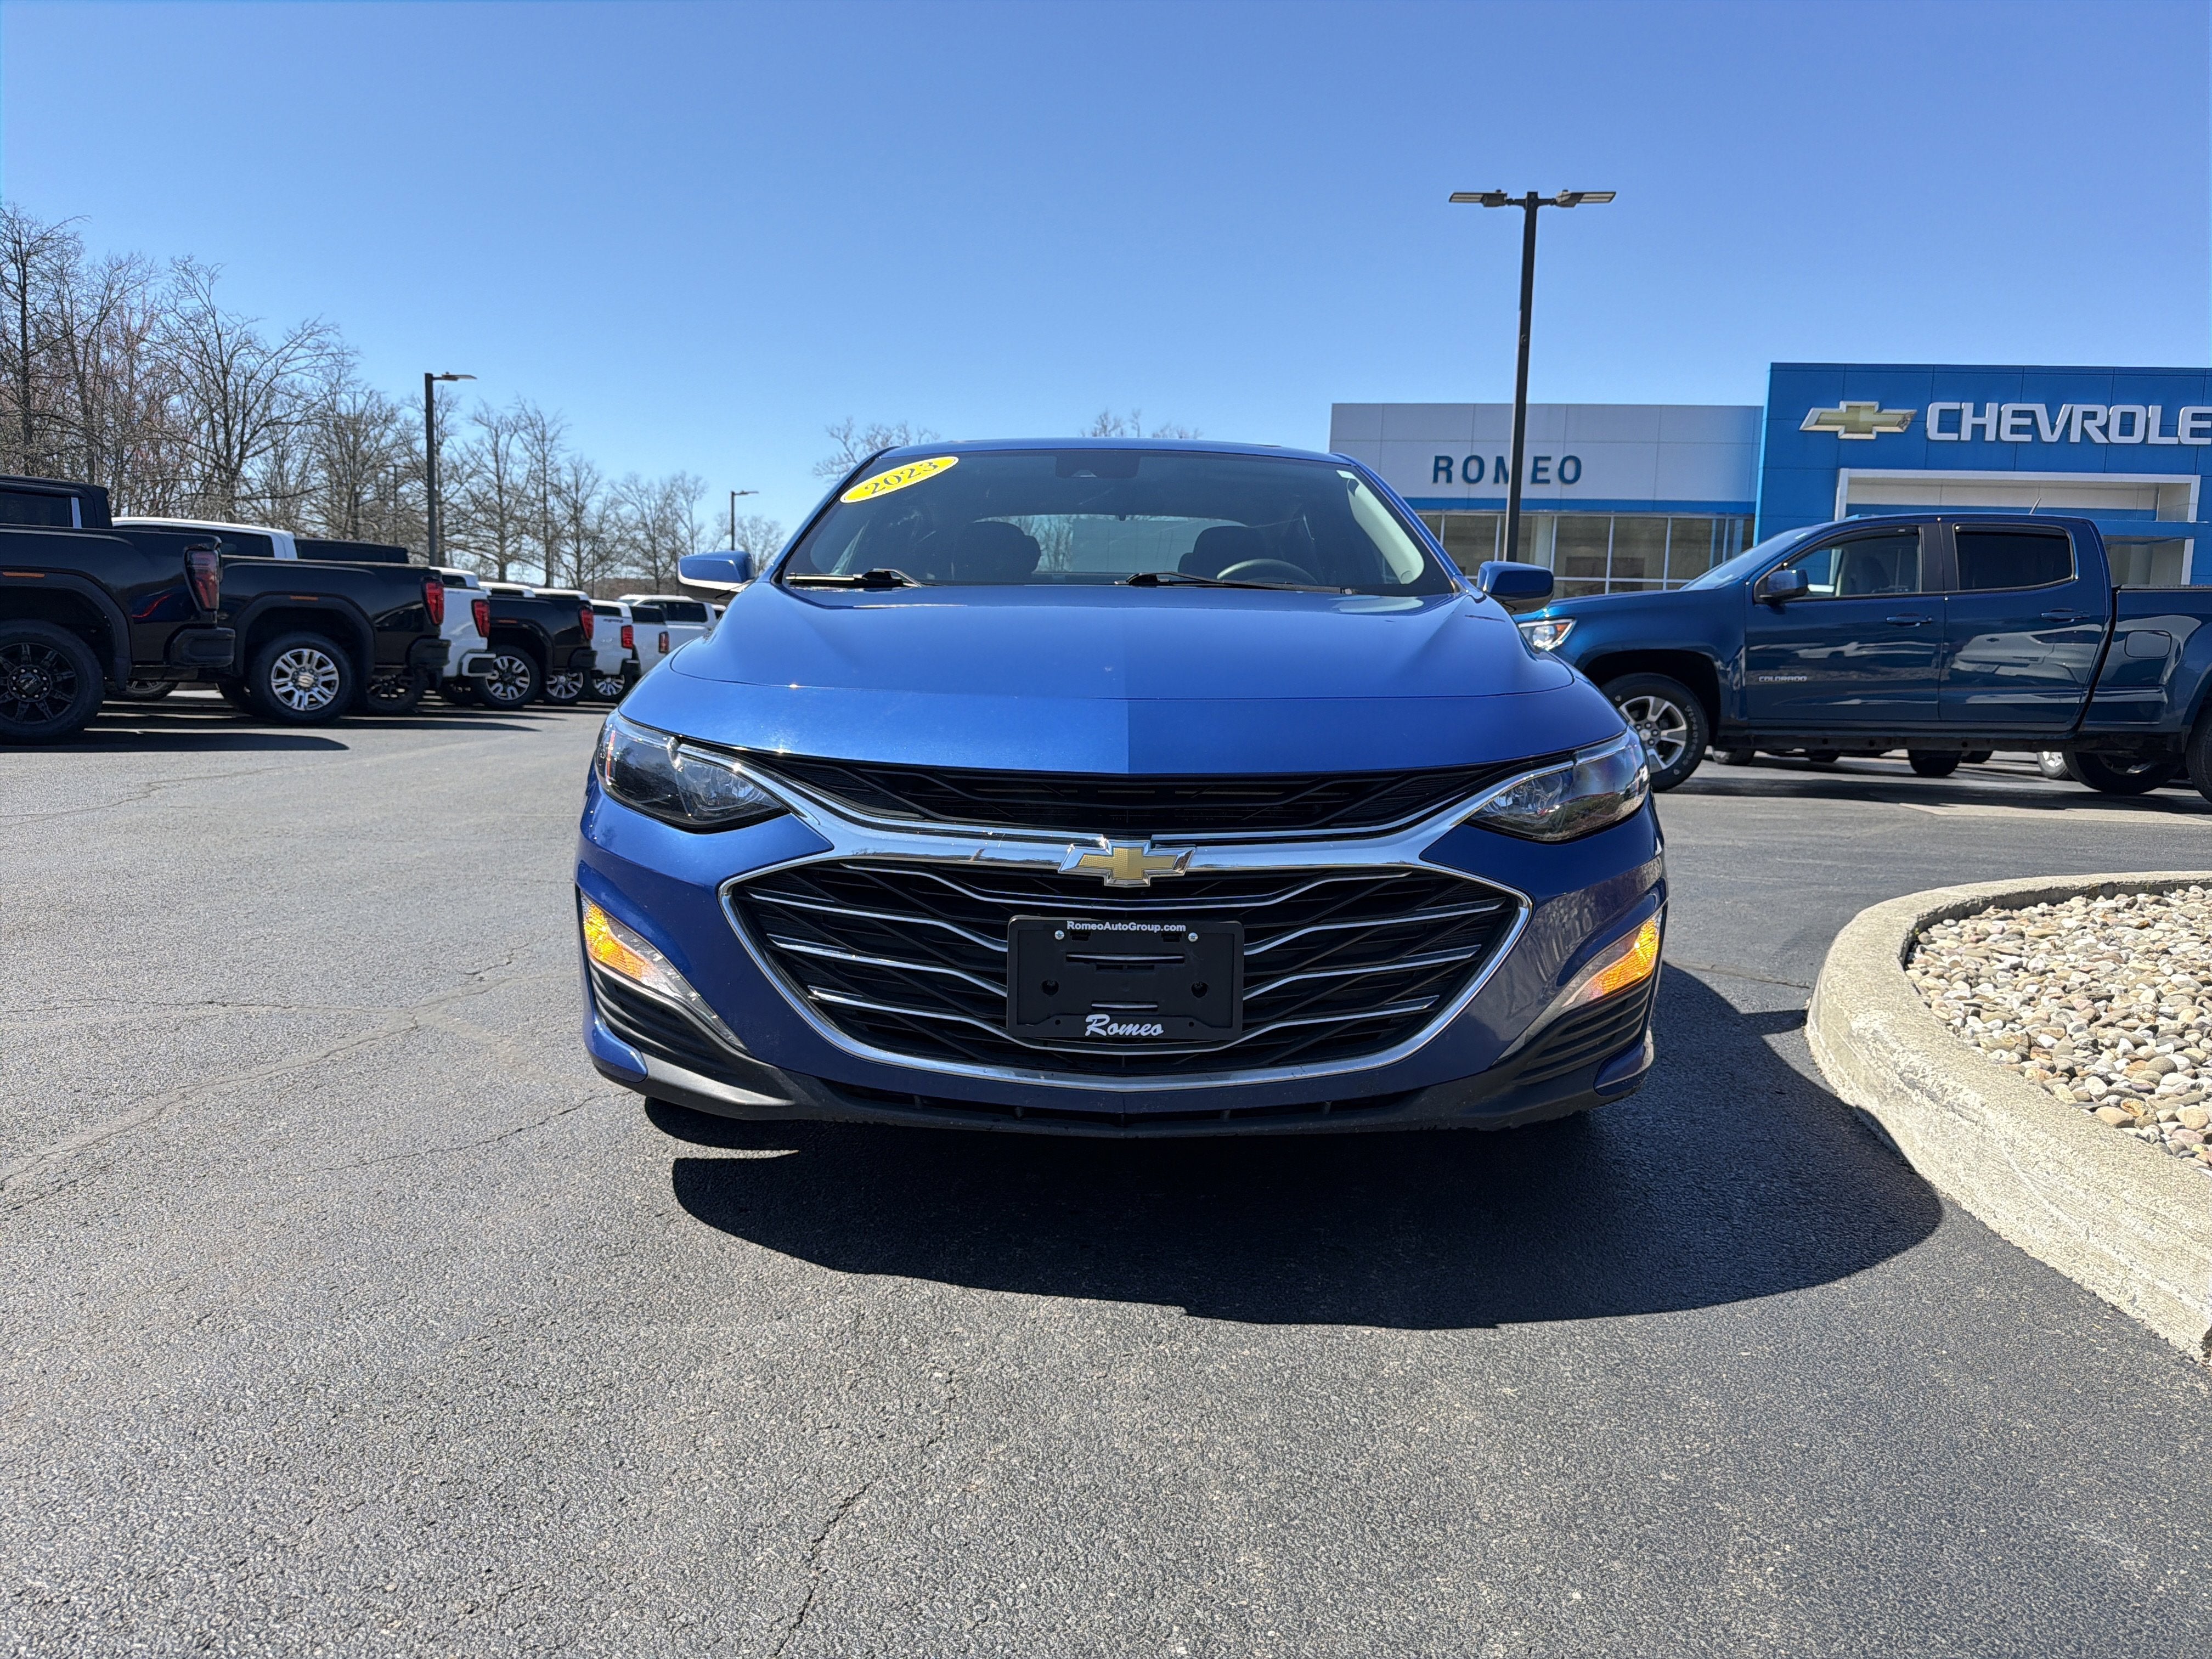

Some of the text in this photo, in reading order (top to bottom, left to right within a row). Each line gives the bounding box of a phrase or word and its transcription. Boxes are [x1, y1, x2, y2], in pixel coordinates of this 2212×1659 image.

[865, 462, 939, 494] 2023
[1066, 921, 1187, 933] RomeoAutoGroup.com
[1085, 1014, 1164, 1036] Romeo
